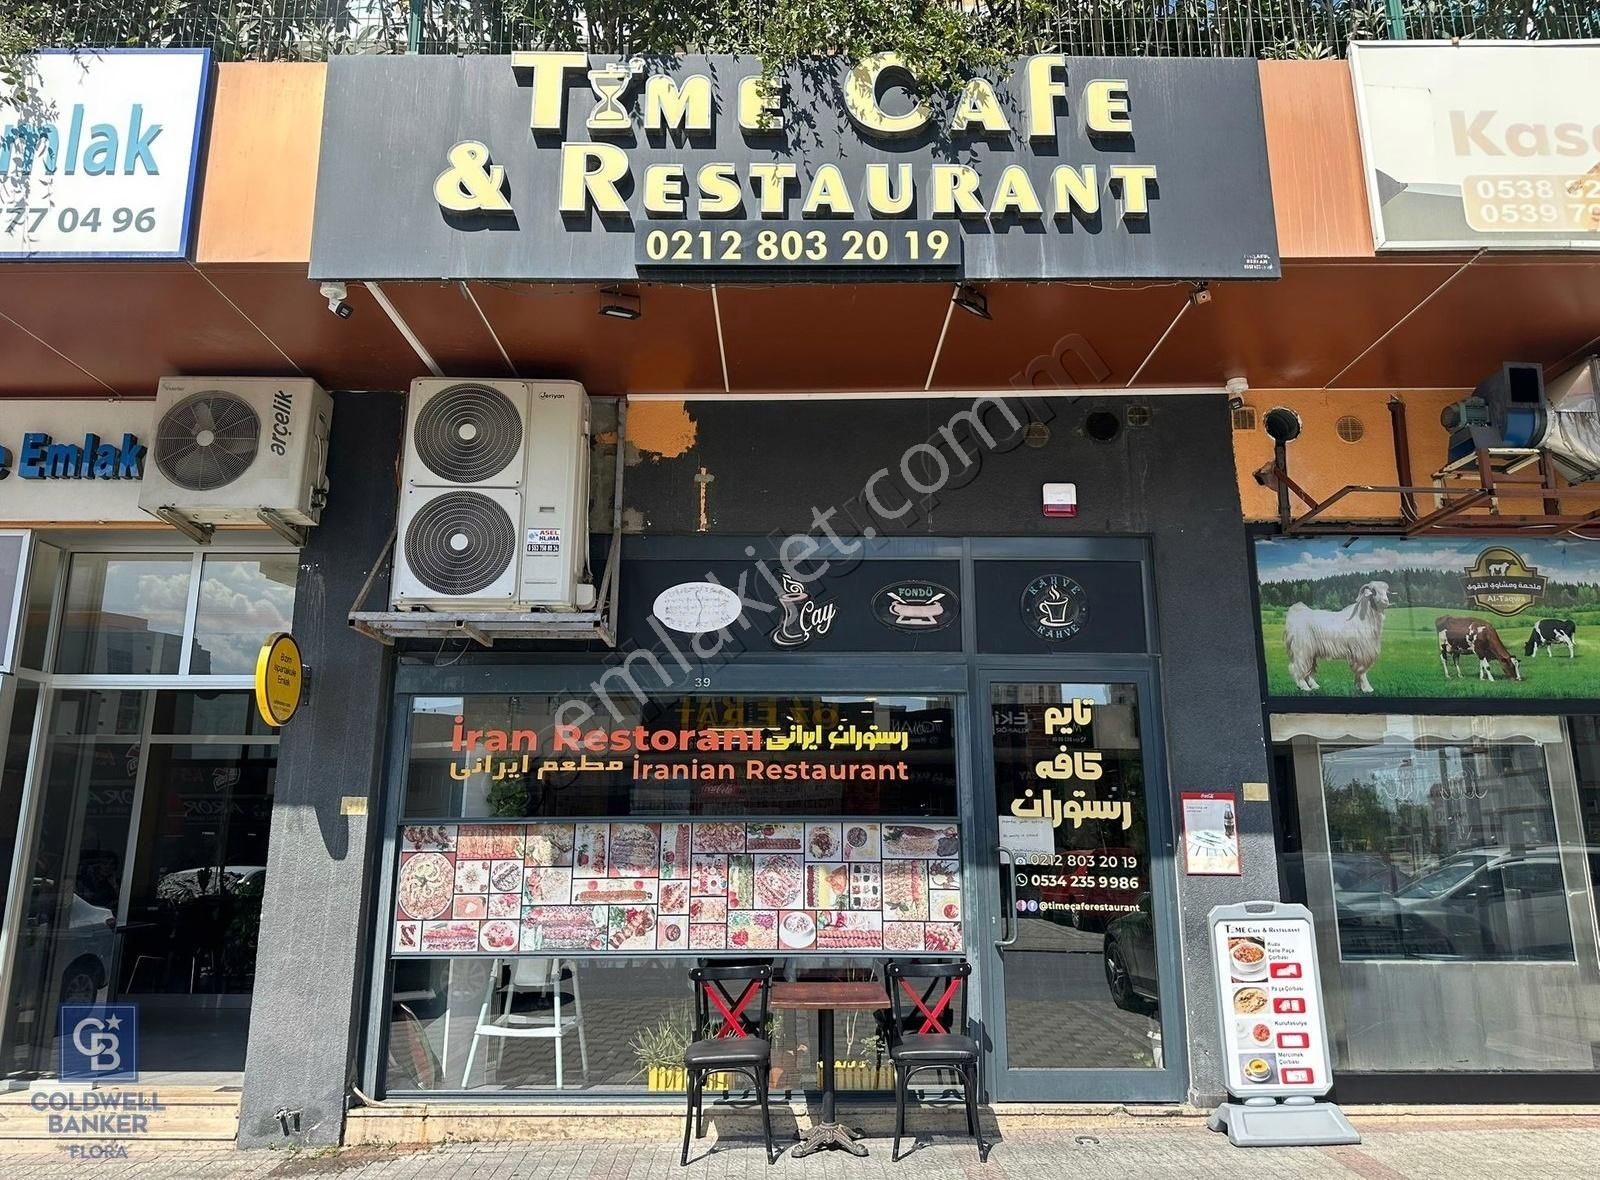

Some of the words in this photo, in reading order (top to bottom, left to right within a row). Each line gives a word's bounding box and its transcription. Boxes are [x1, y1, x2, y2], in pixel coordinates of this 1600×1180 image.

[844, 52, 1133, 137] CAFE
[1448, 109, 1600, 157] Kas
[433, 140, 514, 212] &
[559, 141, 1157, 214] RESTAURANT
[1477, 179, 1554, 200] 0538
[0, 206, 49, 234] 77
[58, 206, 101, 233] 04
[112, 206, 156, 233] 96
[1480, 203, 1559, 223] 0539
[646, 229, 742, 261] 0212
[756, 229, 828, 261] 803
[841, 229, 889, 261] 20
[904, 229, 950, 261] 19
[270, 389, 293, 457] arçelik
[18, 432, 147, 480] Emlak
[898, 587, 934, 598] FONDÜ
[1029, 576, 1081, 596] KAHVE
[801, 600, 837, 642] Çay
[1037, 625, 1080, 639] KAHVE
[694, 677, 711, 688] 39
[537, 754, 624, 780] مطعم
[746, 759, 910, 781] Restaurant
[1010, 788, 1132, 831] رستوران
[1030, 853, 1063, 867] 0212
[1067, 855, 1096, 868] 803
[1099, 855, 1118, 868] 20
[1121, 856, 1138, 869] 19
[1031, 874, 1067, 887] 0534
[1070, 875, 1096, 888] 235
[1098, 876, 1139, 889] 9986
